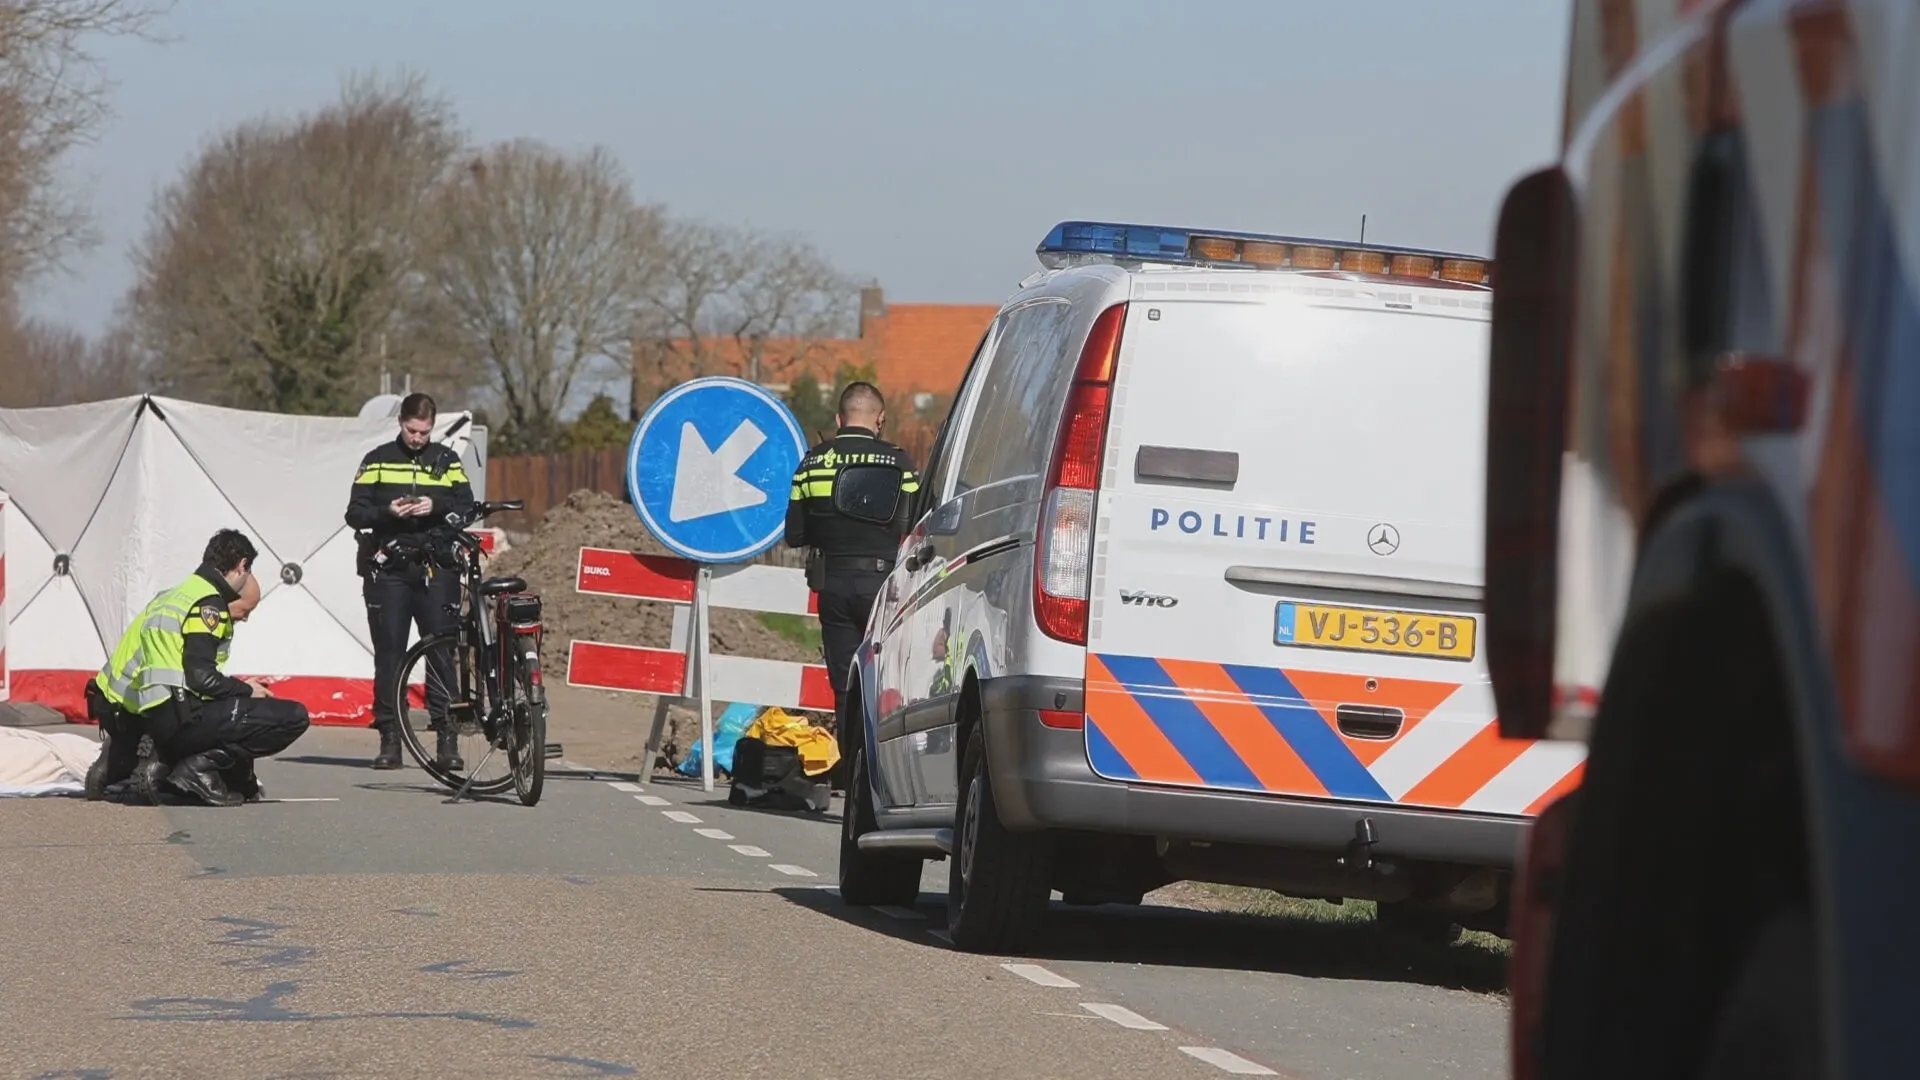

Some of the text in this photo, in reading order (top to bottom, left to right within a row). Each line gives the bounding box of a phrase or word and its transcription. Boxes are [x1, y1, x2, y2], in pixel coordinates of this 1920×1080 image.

[1151, 508, 1316, 544] POLITIE
[1279, 626, 1292, 636] NL
[1309, 610, 1457, 650] VJ-536-B
